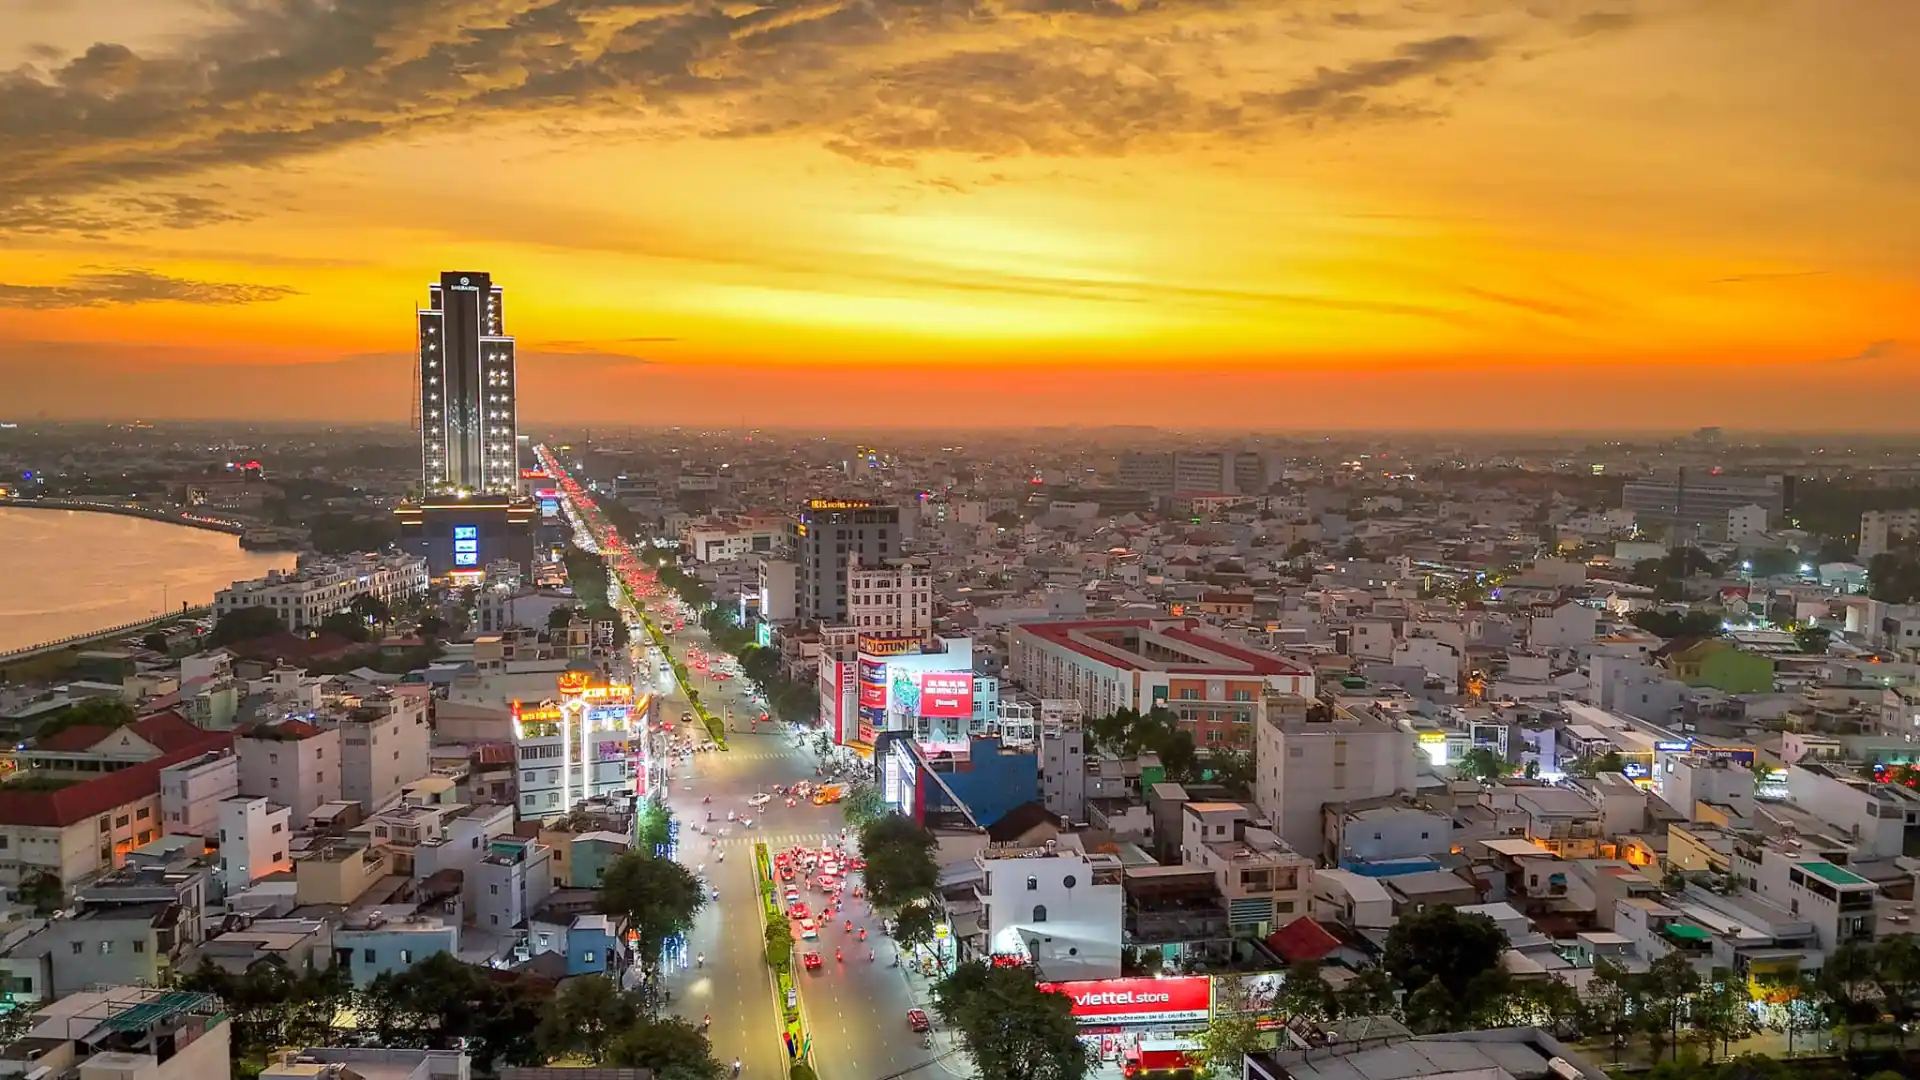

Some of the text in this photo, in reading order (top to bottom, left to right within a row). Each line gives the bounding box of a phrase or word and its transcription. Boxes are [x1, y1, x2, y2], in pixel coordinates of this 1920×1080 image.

[811, 500, 827, 509] IRIS
[872, 642, 905, 652] JOTUN
[583, 687, 607, 698] KIM
[1074, 991, 1169, 1006] viettel store
